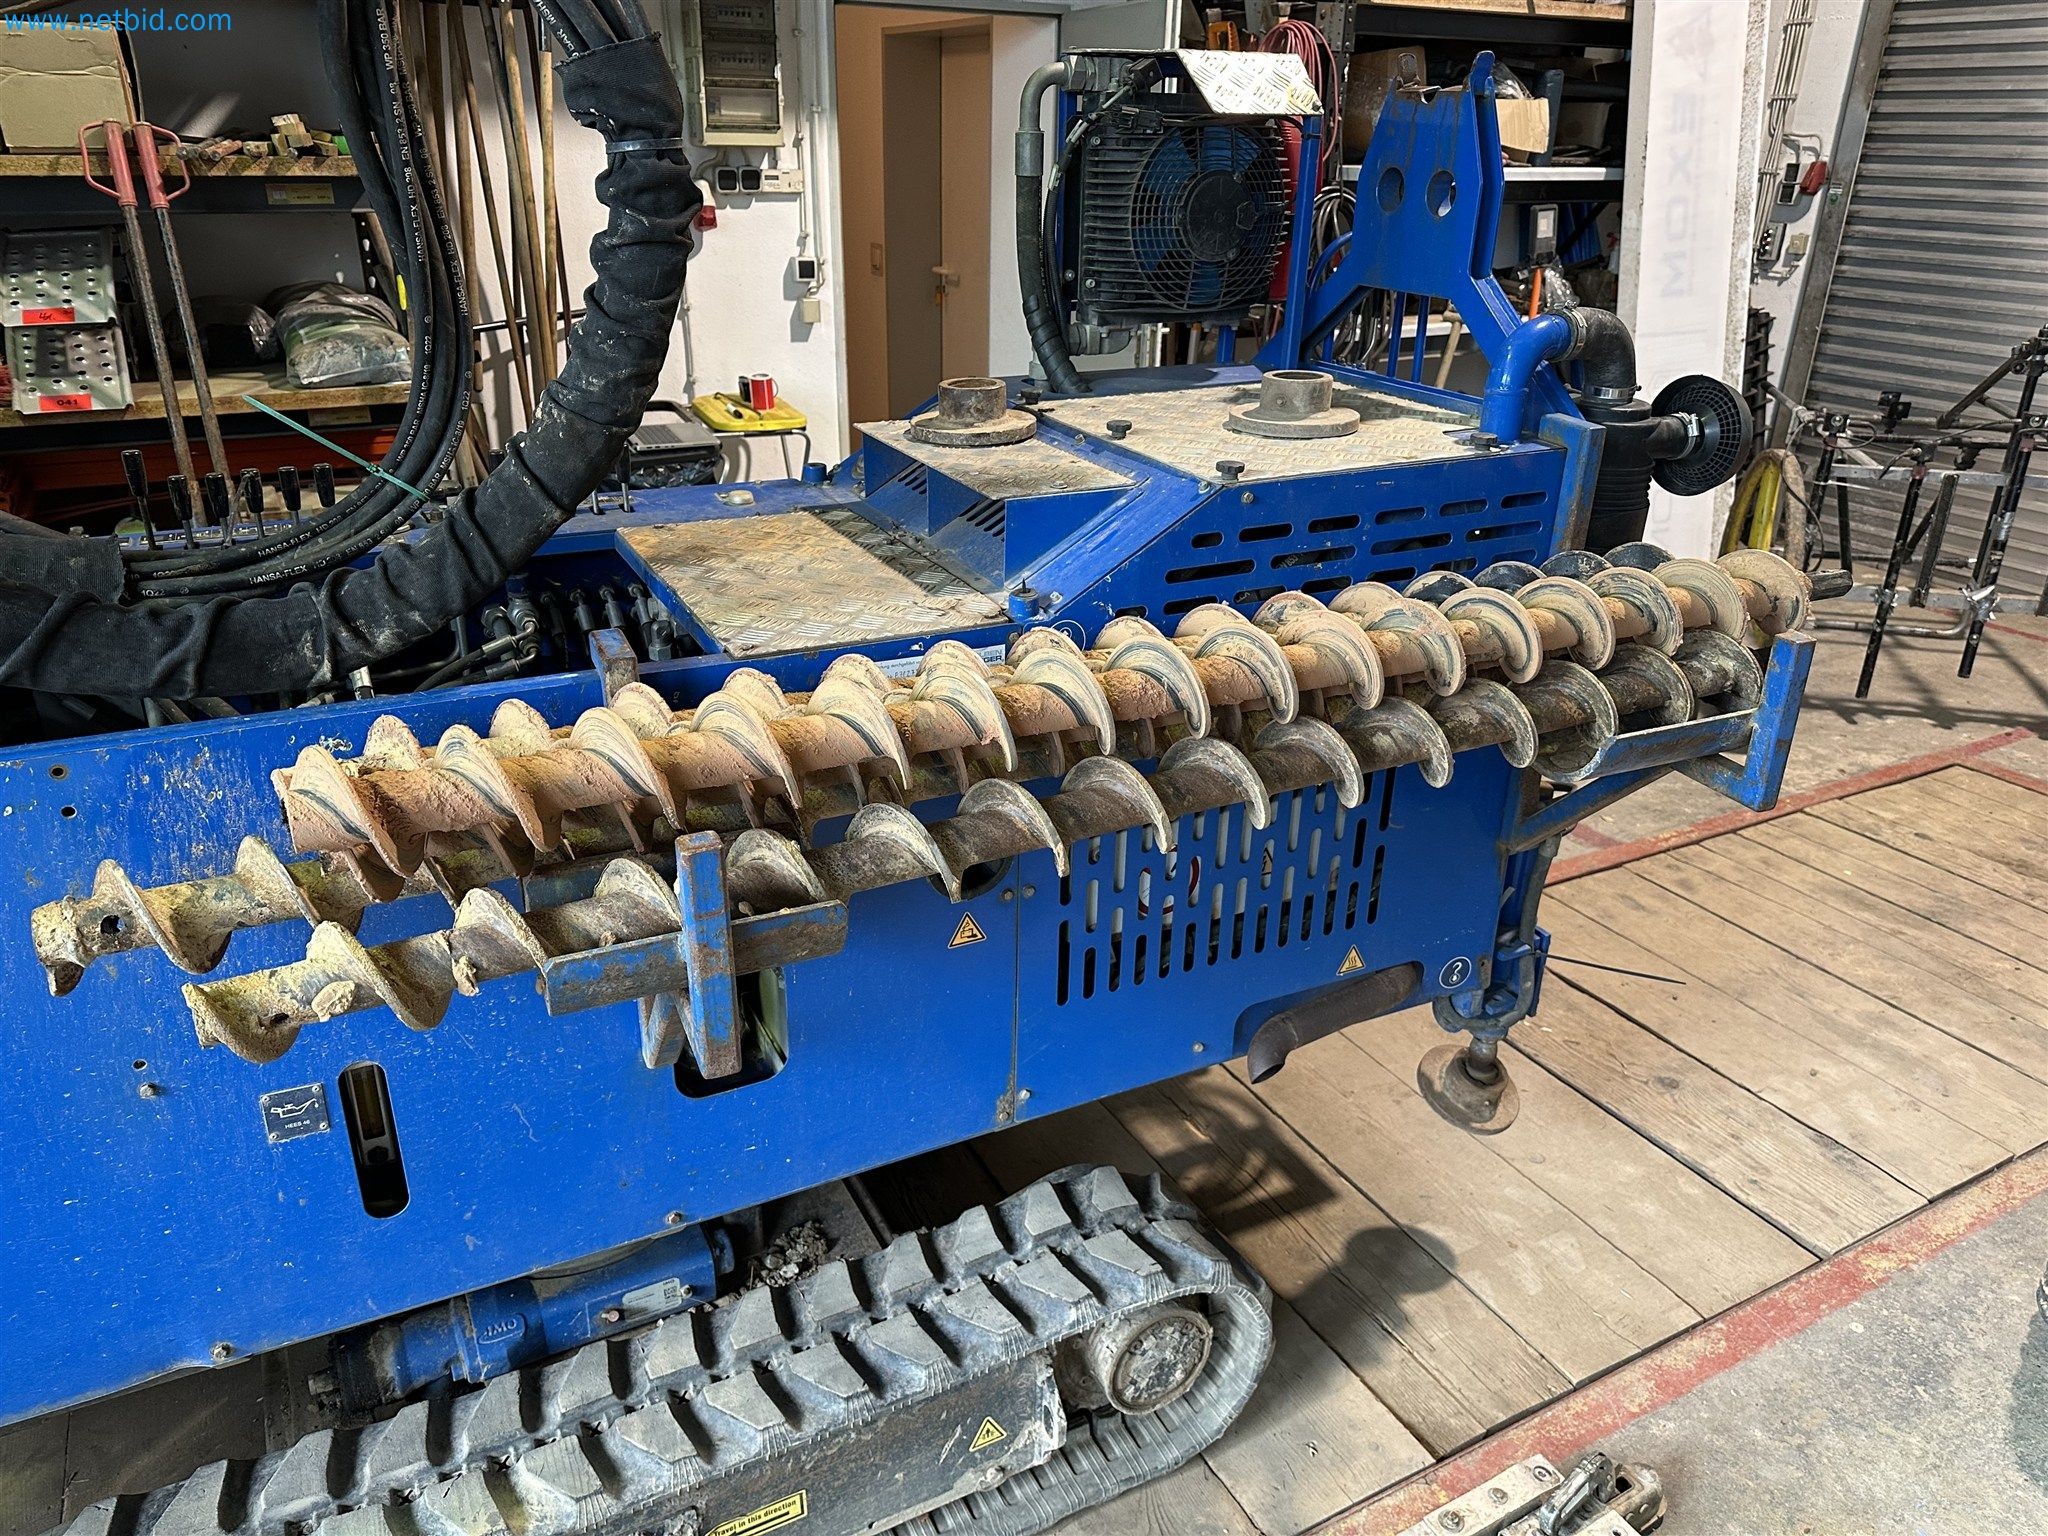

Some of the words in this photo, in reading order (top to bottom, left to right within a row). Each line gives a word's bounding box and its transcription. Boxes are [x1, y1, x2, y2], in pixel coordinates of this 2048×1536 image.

[376, 8, 388, 31] BAR
[380, 33, 391, 51] 350
[384, 52, 394, 71] WP
[400, 146, 410, 161] EN
[445, 241, 455, 255] HD
[449, 260, 469, 316] HANSA-FLEX
[249, 564, 308, 585] HANSA-FLEX
[461, 390, 471, 411] 1Q22
[257, 531, 313, 558] HANSA-FLEX
[714, 1523, 737, 1536] Travel
[747, 1513, 762, 1524] this
[763, 1499, 797, 1517] direction
